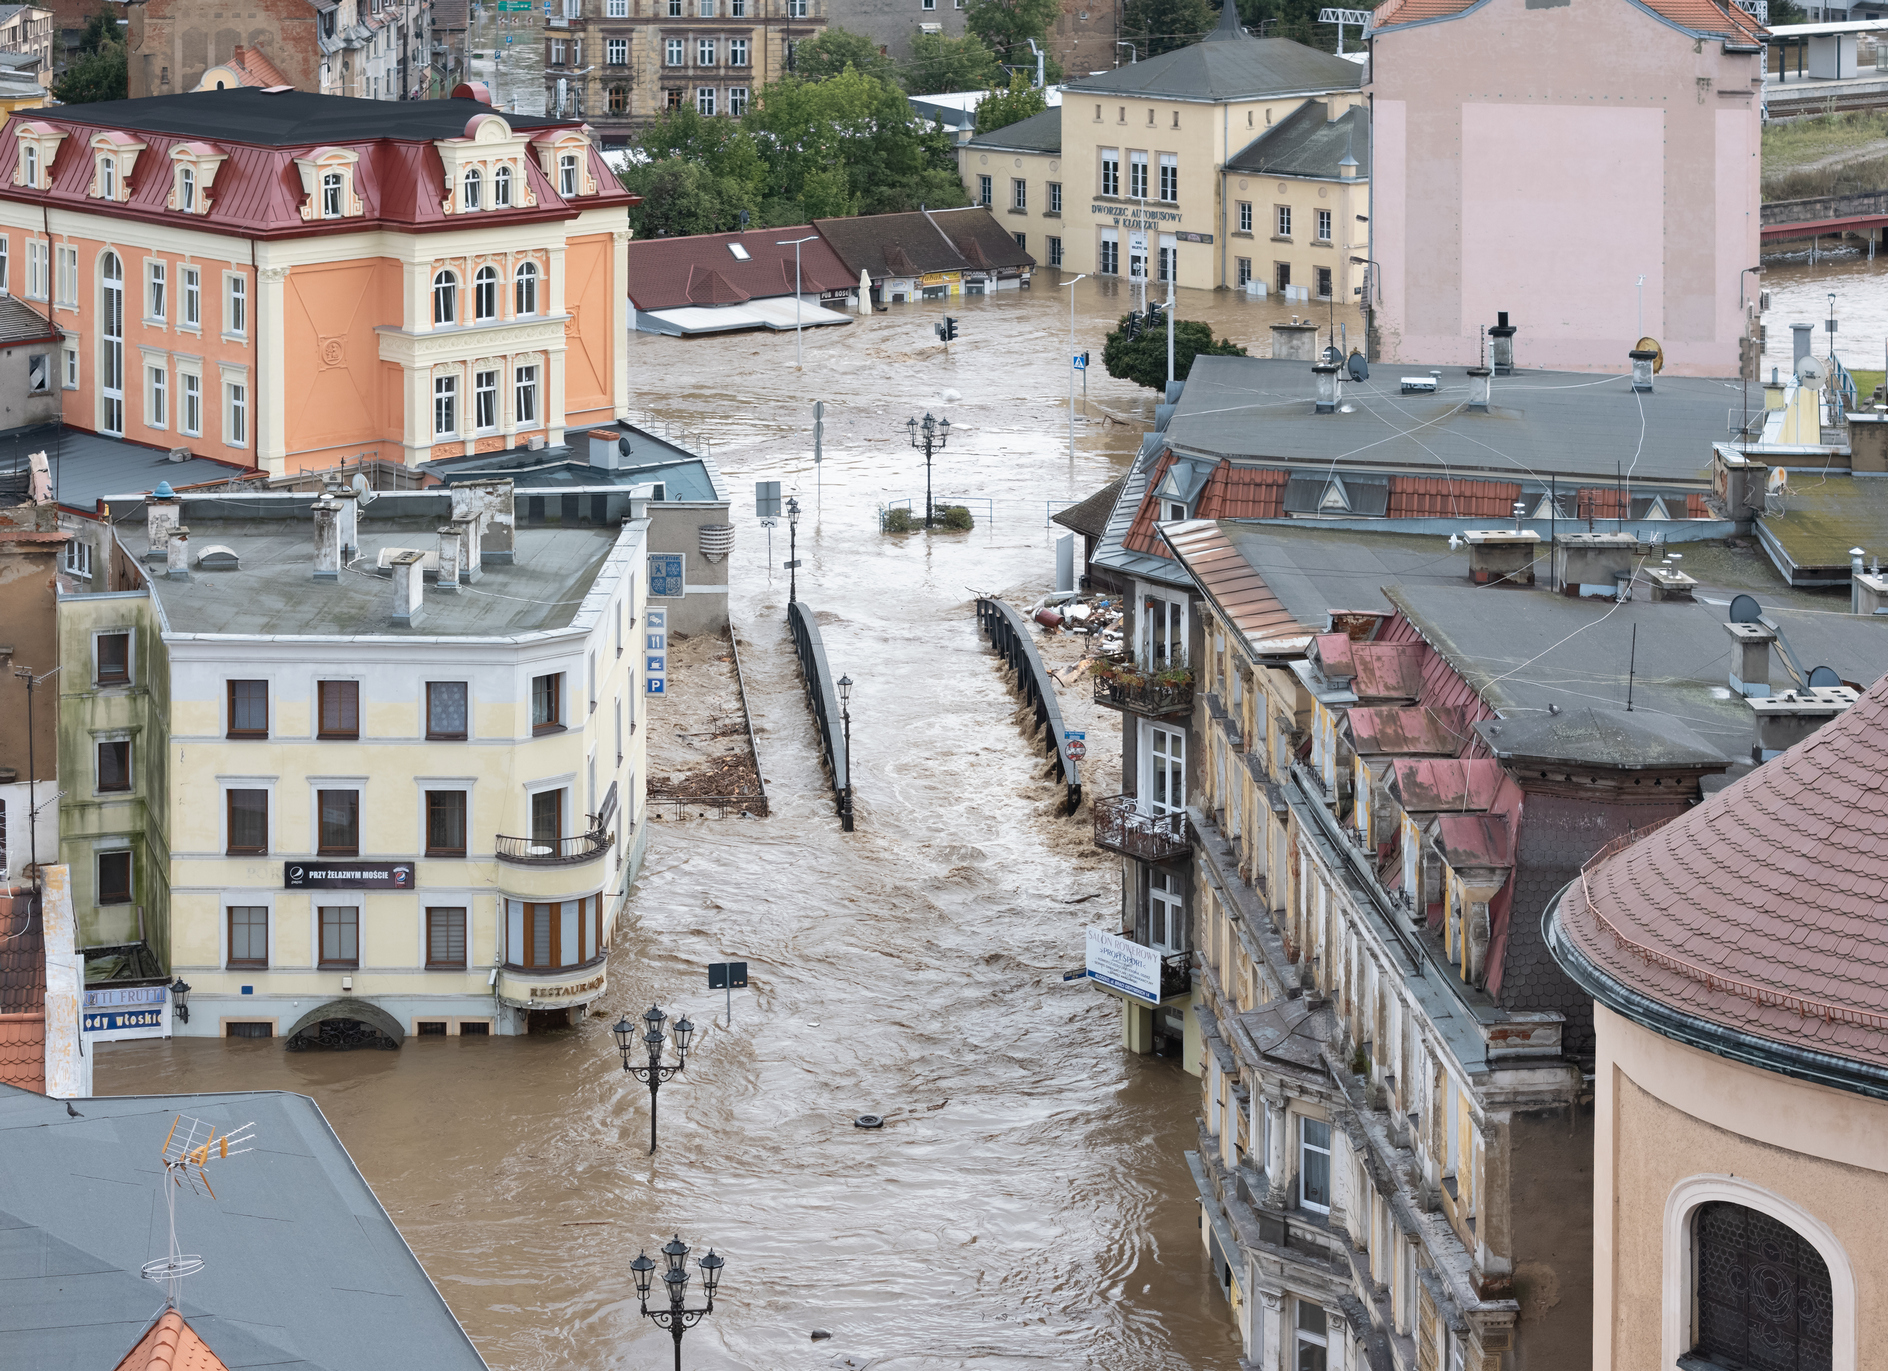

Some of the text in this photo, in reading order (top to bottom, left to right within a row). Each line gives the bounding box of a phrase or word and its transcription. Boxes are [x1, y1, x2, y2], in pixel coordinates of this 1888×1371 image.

[1092, 204, 1182, 223] DWORZEC AUTOBUSOWY
[1123, 218, 1159, 230] KŁODZKU
[652, 680, 660, 691] P
[327, 870, 361, 879] ŻELAZNYM
[362, 870, 388, 879] MOŚCIE
[1088, 930, 1112, 946] SALON
[1114, 940, 1158, 963] ROWEROWY
[120, 988, 164, 1002] FRUTTI
